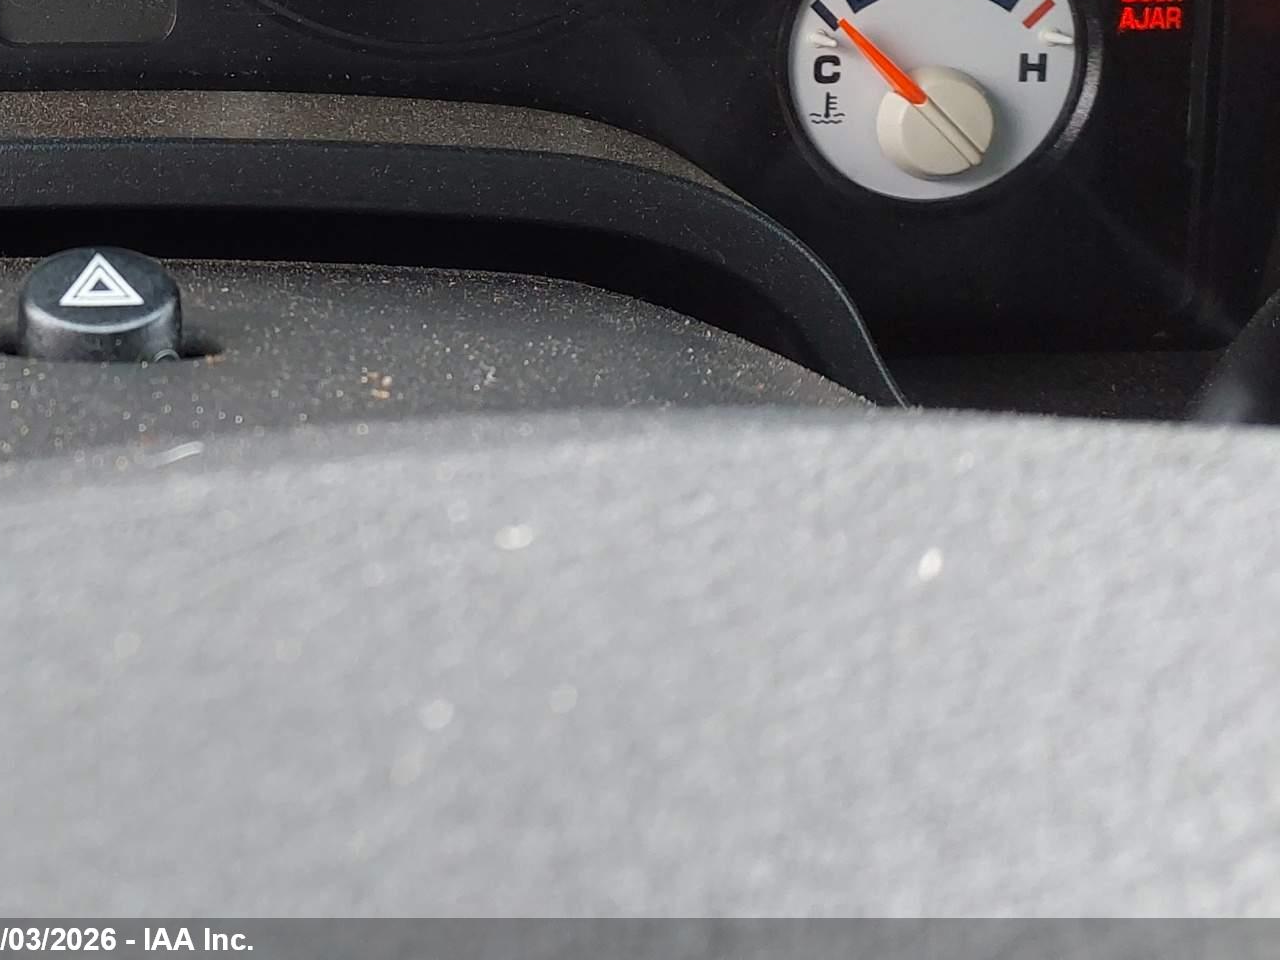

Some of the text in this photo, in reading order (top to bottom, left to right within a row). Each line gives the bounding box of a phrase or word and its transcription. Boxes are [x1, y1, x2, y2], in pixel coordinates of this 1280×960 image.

[1120, 7, 1181, 29] AJAR
[814, 55, 840, 84] C
[1019, 53, 1047, 82] H
